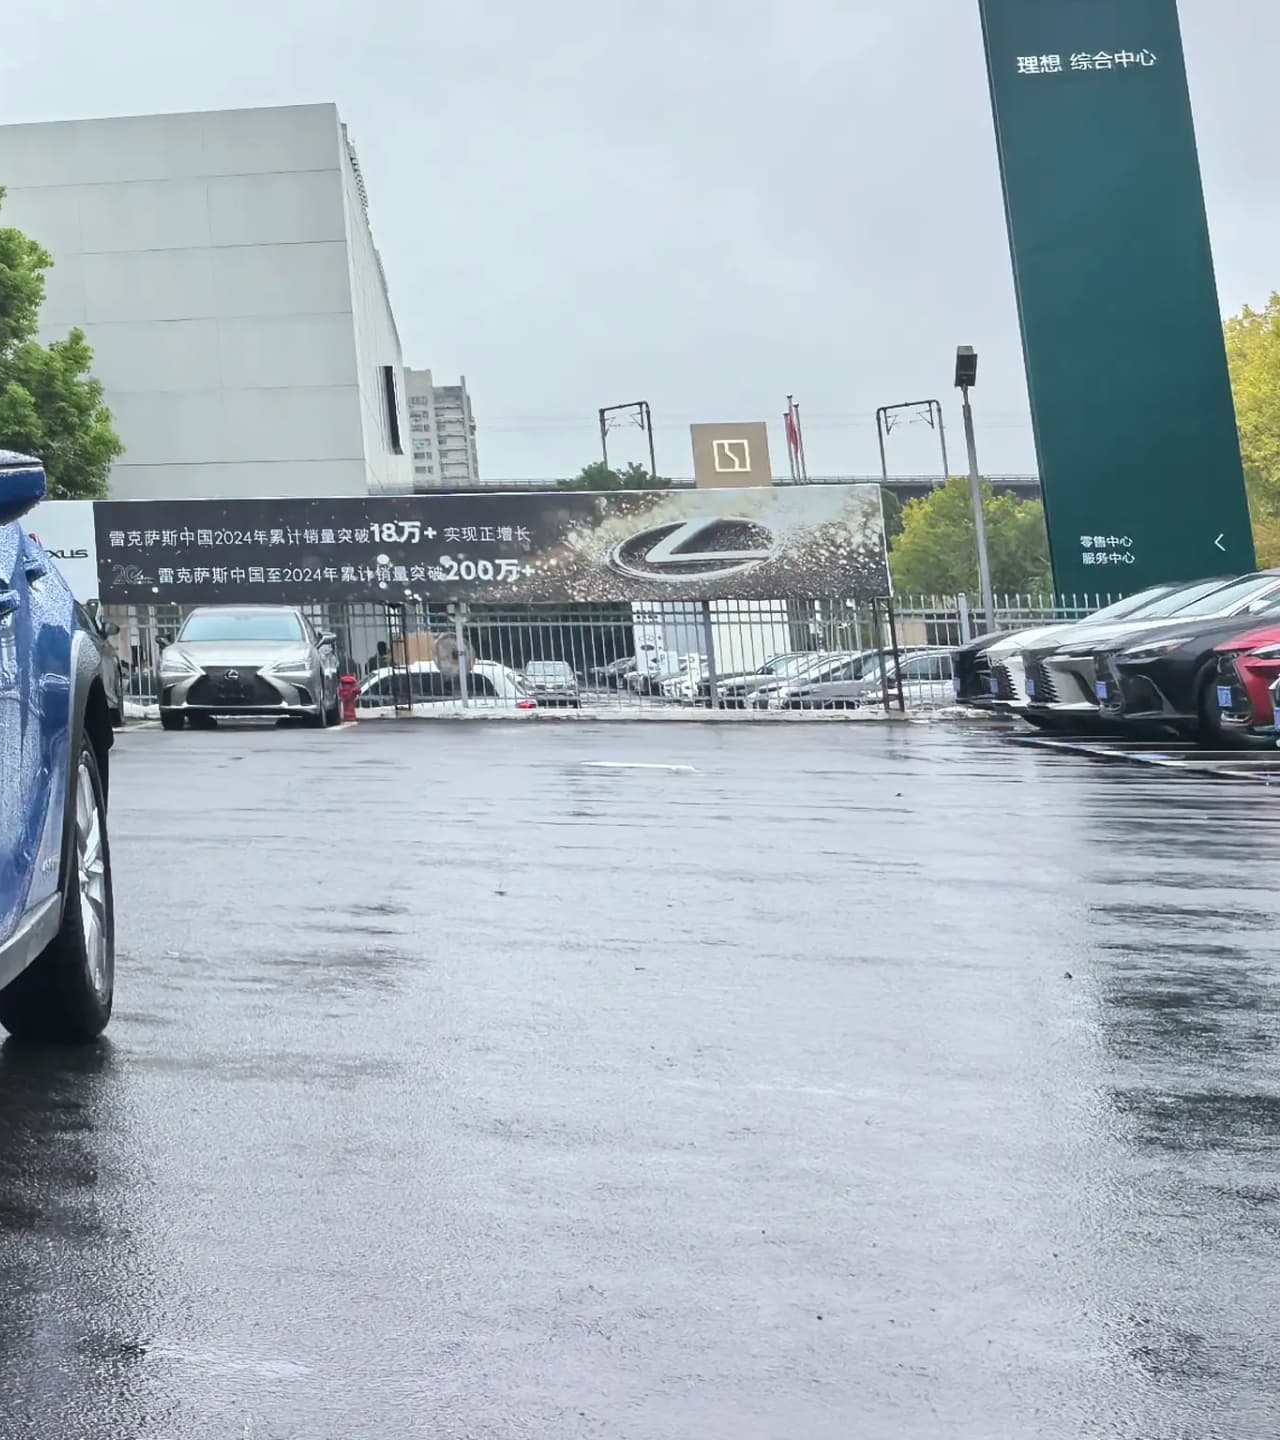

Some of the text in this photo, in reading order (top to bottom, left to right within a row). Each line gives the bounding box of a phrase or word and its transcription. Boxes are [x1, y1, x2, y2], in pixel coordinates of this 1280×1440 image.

[1016, 48, 1157, 75] 理想 综合中心
[443, 526, 533, 543] 实现正增长
[1080, 535, 1133, 548] 零售中心
[44, 548, 90, 559] XUS
[1082, 551, 1135, 565] 服务中心
